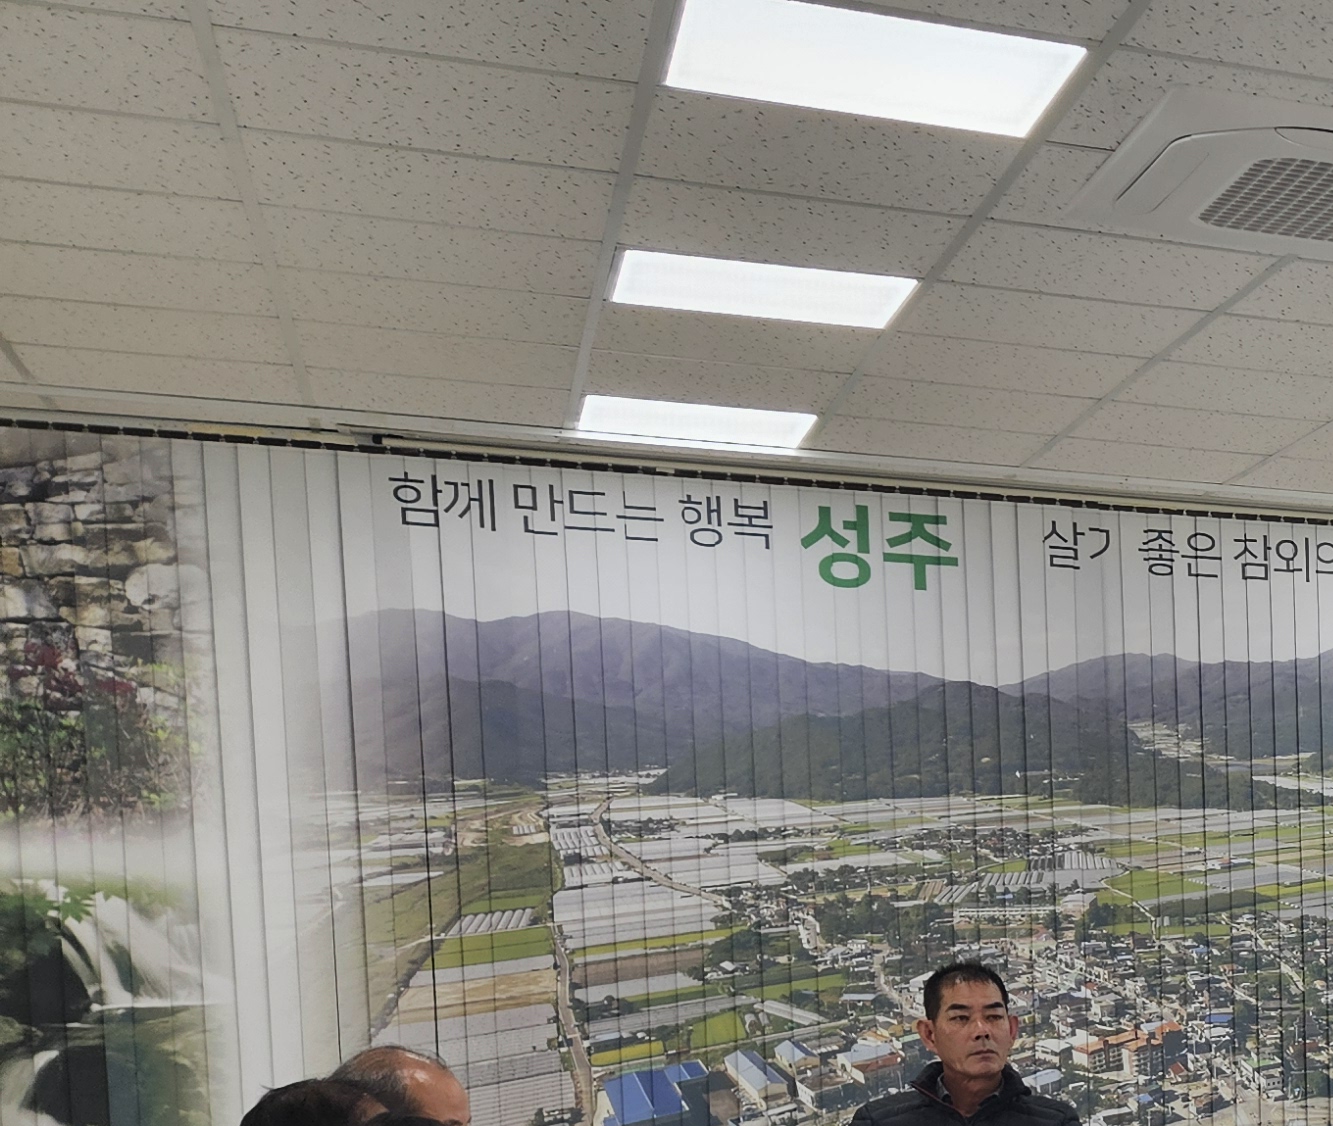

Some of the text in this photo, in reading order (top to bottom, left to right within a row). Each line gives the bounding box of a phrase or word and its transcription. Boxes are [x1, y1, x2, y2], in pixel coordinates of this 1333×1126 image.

[388, 472, 959, 591] 함께 만드는 행복 성주
[1042, 520, 1111, 570] 살기
[1138, 529, 1223, 578] 좋은
